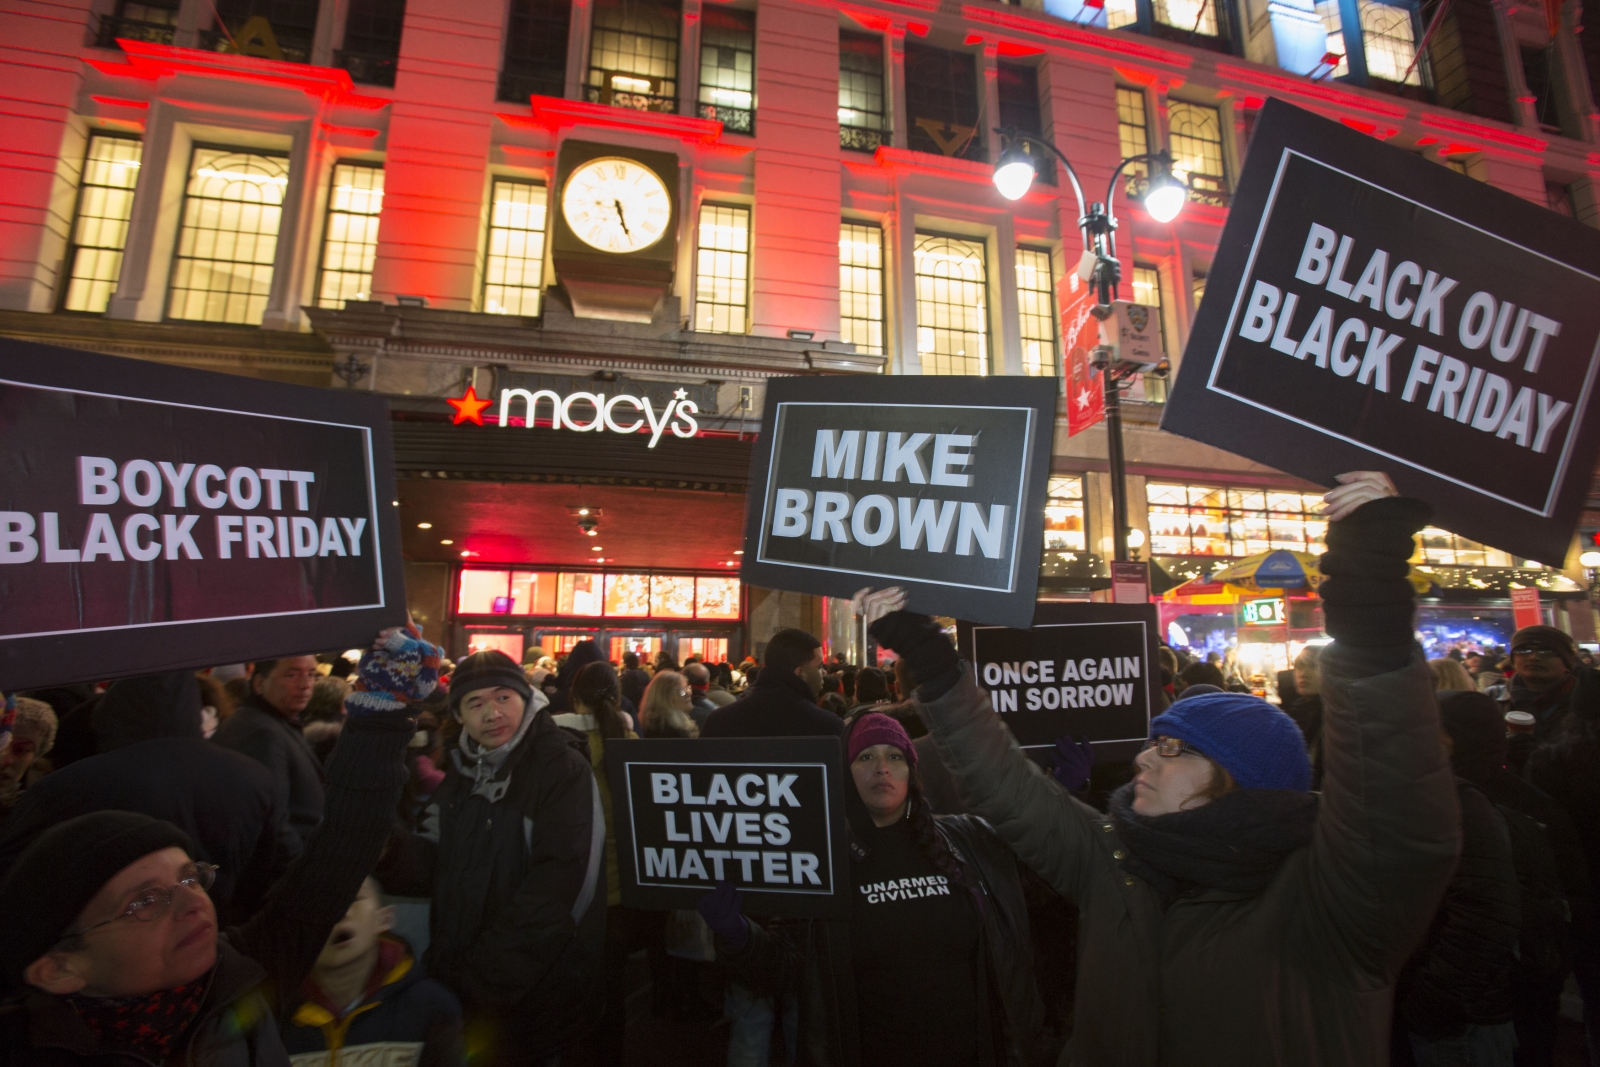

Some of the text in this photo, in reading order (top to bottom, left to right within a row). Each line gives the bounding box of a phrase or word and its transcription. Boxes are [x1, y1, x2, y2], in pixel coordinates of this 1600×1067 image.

[1295, 222, 1562, 373] BLACK OUT
[1239, 280, 1572, 453] BLACK FRIDAY
[811, 429, 976, 487] MIKE
[77, 455, 315, 511] BOYCOTT
[0, 511, 367, 564] BLACK FRIDAY
[772, 488, 1008, 559] BROWN
[983, 656, 1141, 686] ONCE AGAIN
[991, 683, 1134, 713] IN SORROW
[650, 772, 801, 807] BLACK
[664, 811, 791, 846] LIVES
[643, 847, 822, 885] MATTER
[860, 875, 948, 894] UNARMED
[867, 885, 951, 904] CIVILIAN
